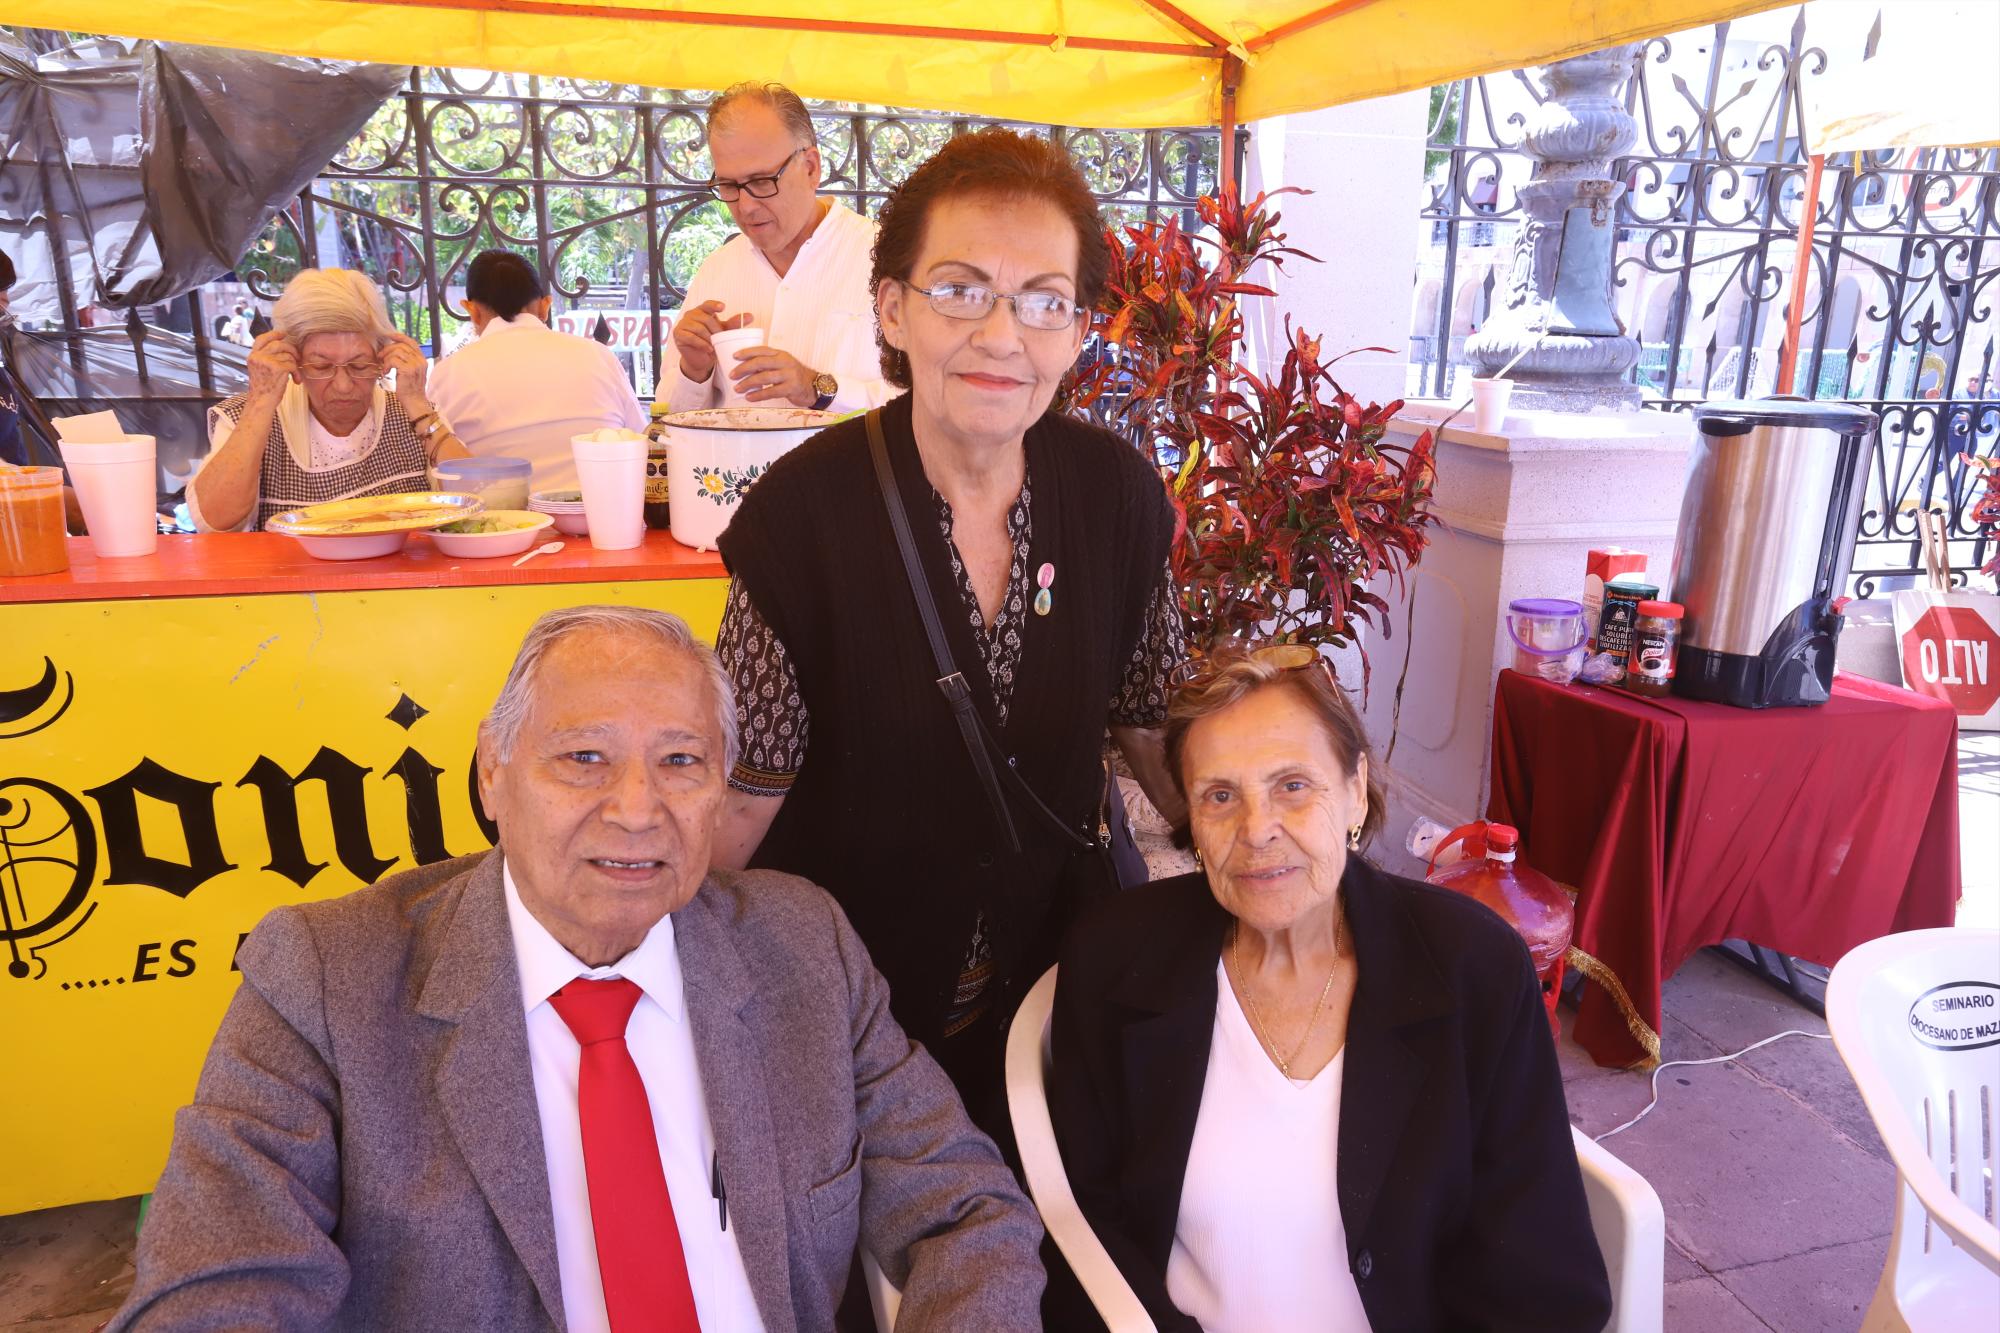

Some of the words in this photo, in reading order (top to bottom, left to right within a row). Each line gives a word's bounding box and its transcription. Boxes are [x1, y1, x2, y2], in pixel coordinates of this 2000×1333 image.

[1920, 638, 1988, 685] ALTO
[1932, 994, 1994, 1012] SEMINARIO
[1911, 1014, 1958, 1041] DIOCESANO
[1960, 1027, 1974, 1040] DE
[1975, 1019, 2000, 1038] MAZ
